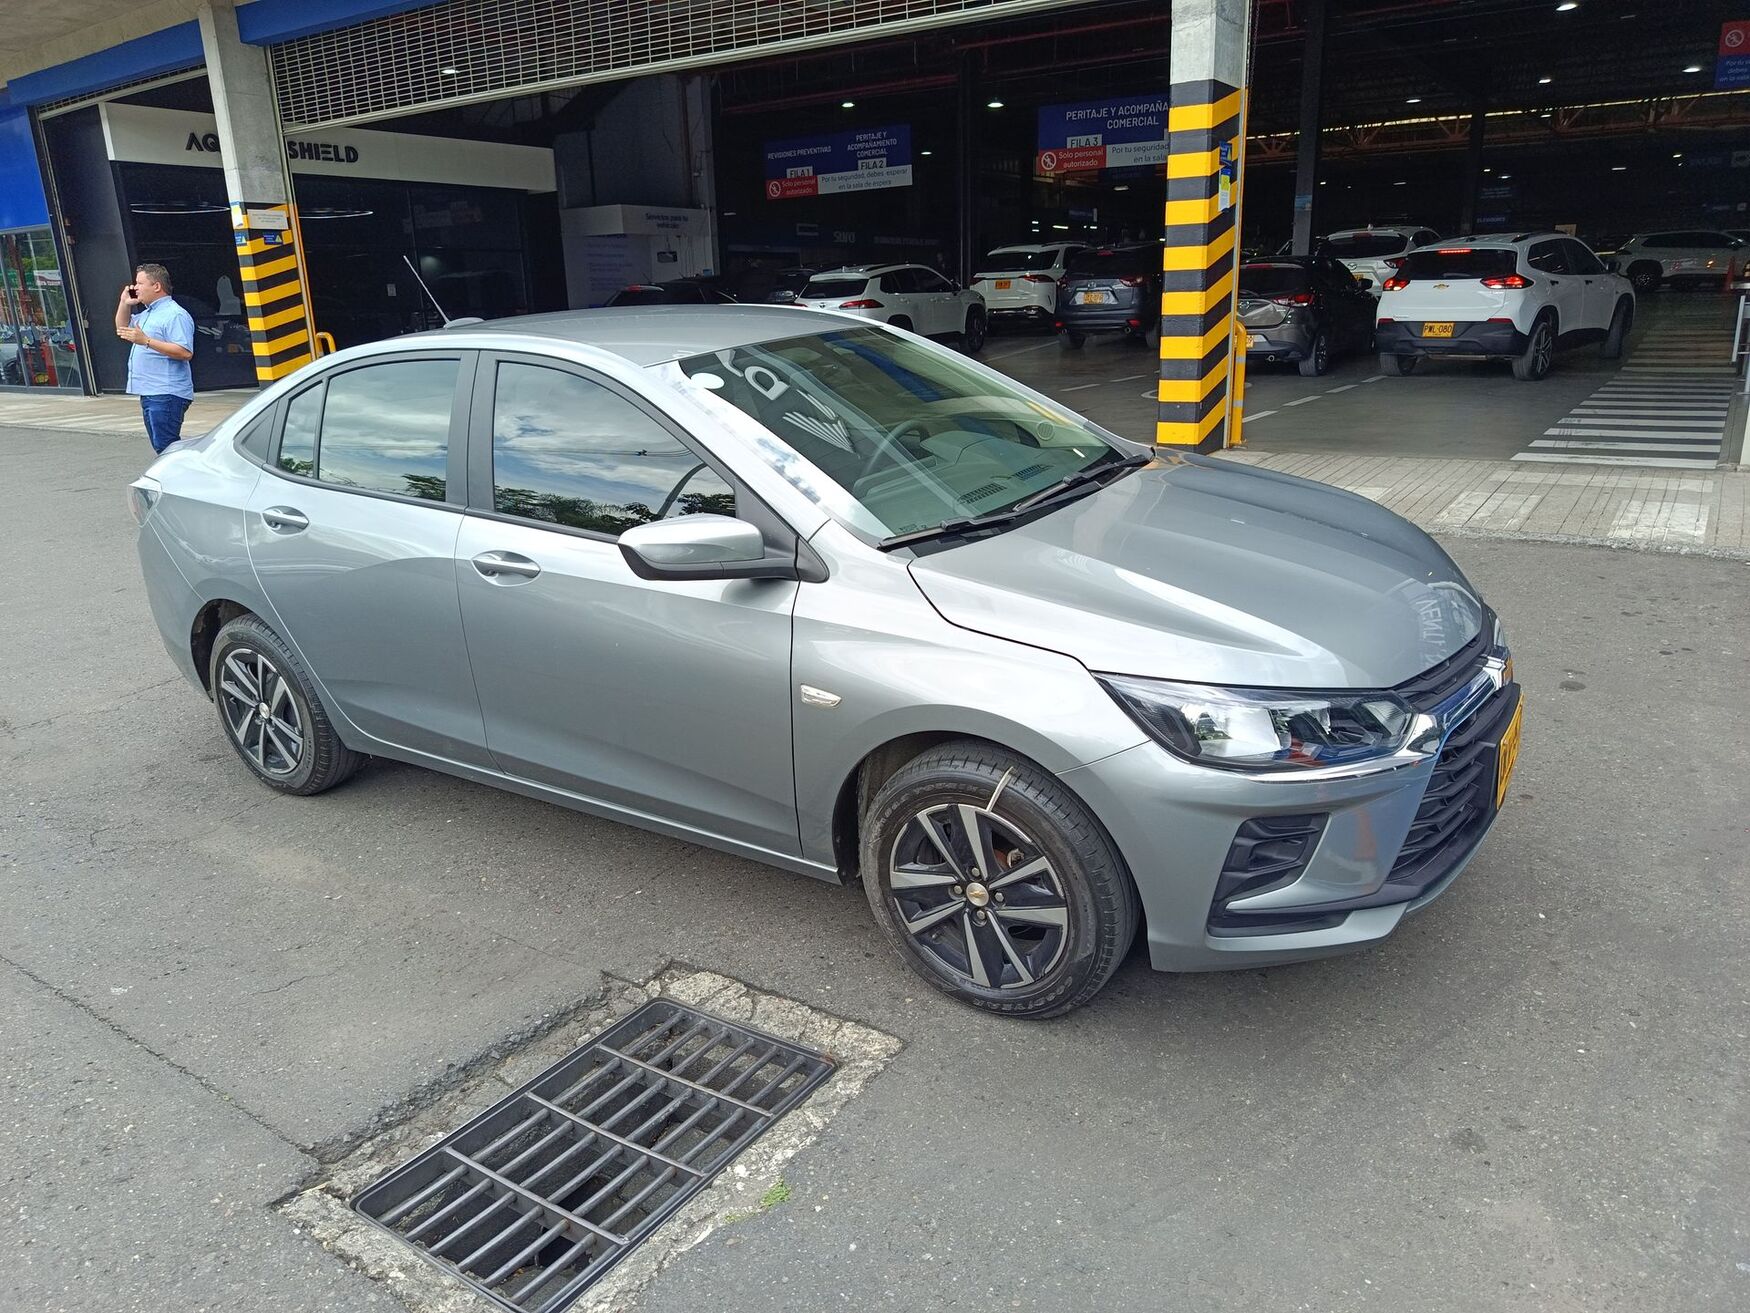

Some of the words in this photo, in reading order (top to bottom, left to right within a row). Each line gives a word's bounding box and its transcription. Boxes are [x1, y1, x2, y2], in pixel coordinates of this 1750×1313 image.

[1066, 107, 1109, 121] PERITAJE
[1111, 106, 1117, 117] Y
[1107, 115, 1159, 129] COMERCIAL
[856, 131, 882, 142] PERITAJE
[1070, 137, 1091, 148] FILA
[1092, 136, 1099, 146] 3
[847, 138, 898, 151] ACOMPAÑAMIENTO
[1111, 146, 1123, 154] Por
[287, 140, 359, 163] SHIELD
[767, 149, 797, 160] REVISIONES
[797, 145, 832, 156] PREVENTIVAS
[856, 148, 888, 158] COMERCIAL
[1058, 150, 1074, 160] Solo
[1074, 149, 1105, 160] personal
[860, 160, 877, 170] FILA
[1063, 159, 1098, 169] autorizado
[789, 169, 806, 178] FILA
